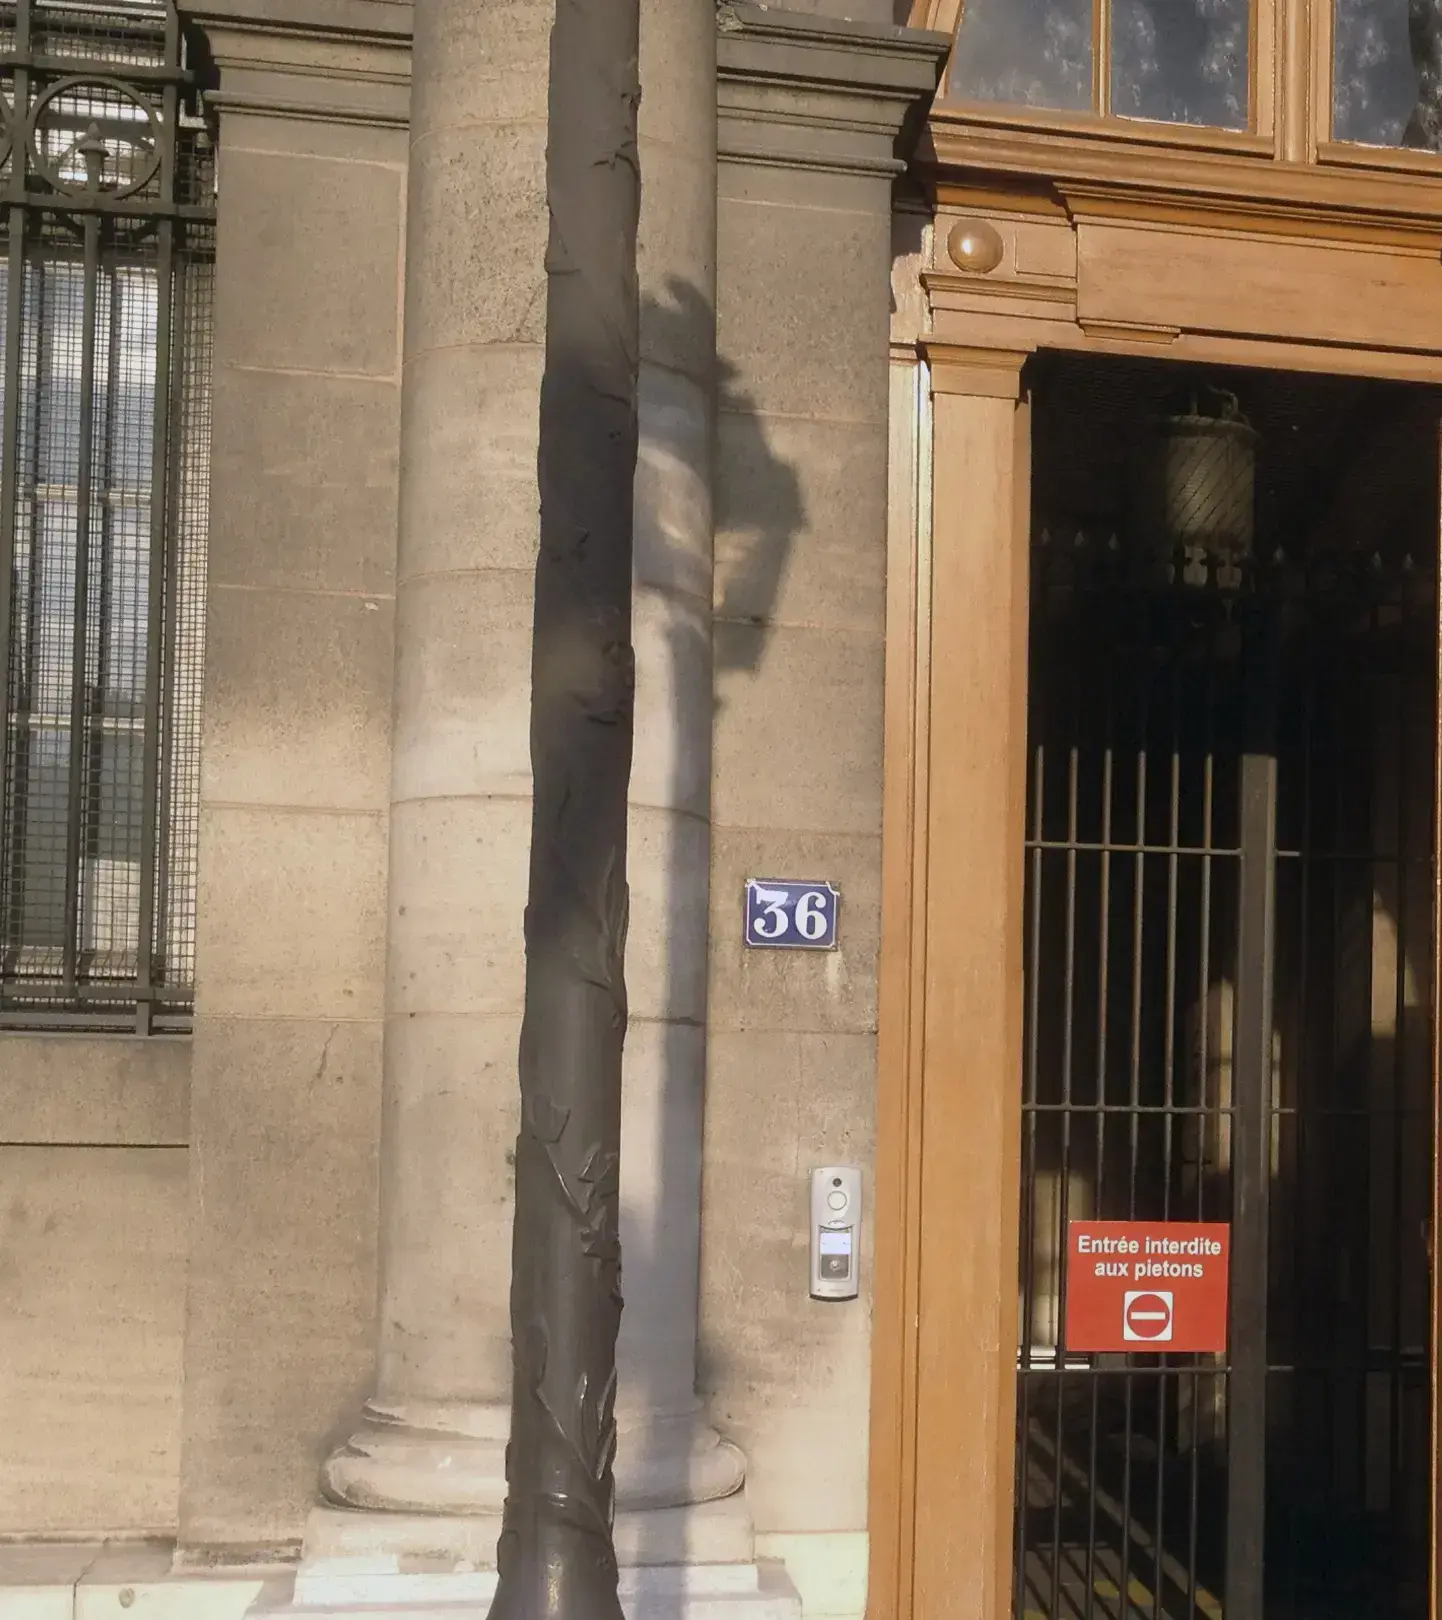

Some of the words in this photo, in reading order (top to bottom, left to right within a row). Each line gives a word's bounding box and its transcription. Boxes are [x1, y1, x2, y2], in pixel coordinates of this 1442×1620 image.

[753, 888, 828, 940] 36
[1078, 1235, 1139, 1253] Entrée
[1145, 1236, 1221, 1255] interdite
[1094, 1261, 1128, 1276] aux
